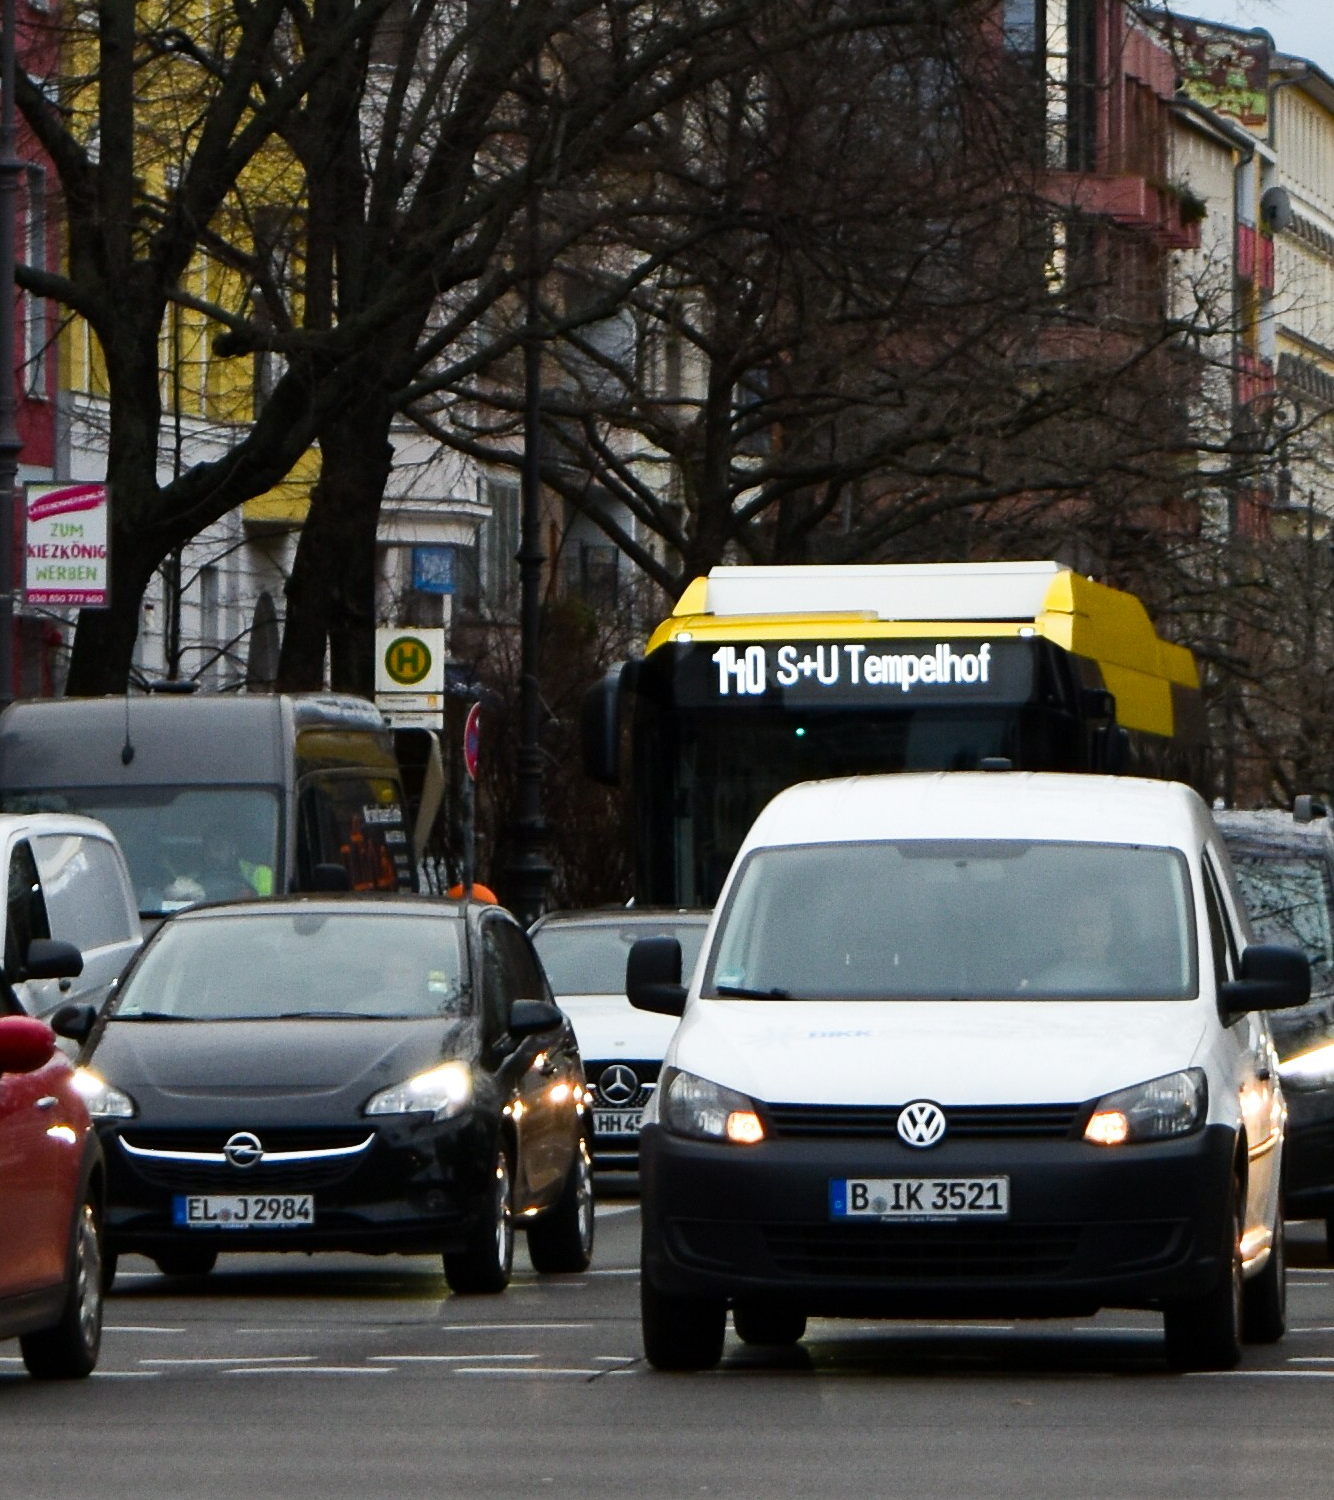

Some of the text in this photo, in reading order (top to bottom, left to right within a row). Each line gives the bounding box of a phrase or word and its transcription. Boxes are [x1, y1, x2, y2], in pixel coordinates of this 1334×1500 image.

[50, 523, 84, 538] ZUM
[27, 540, 107, 559] KIEZKÖNIG
[35, 564, 97, 581] WERBEN
[68, 593, 84, 602] 777
[712, 642, 991, 695] 140 S+U Tempelhof
[598, 1114, 621, 1132] HH
[850, 1182, 1003, 1210] B IK 3521
[188, 1198, 310, 1220] EL J 2984
